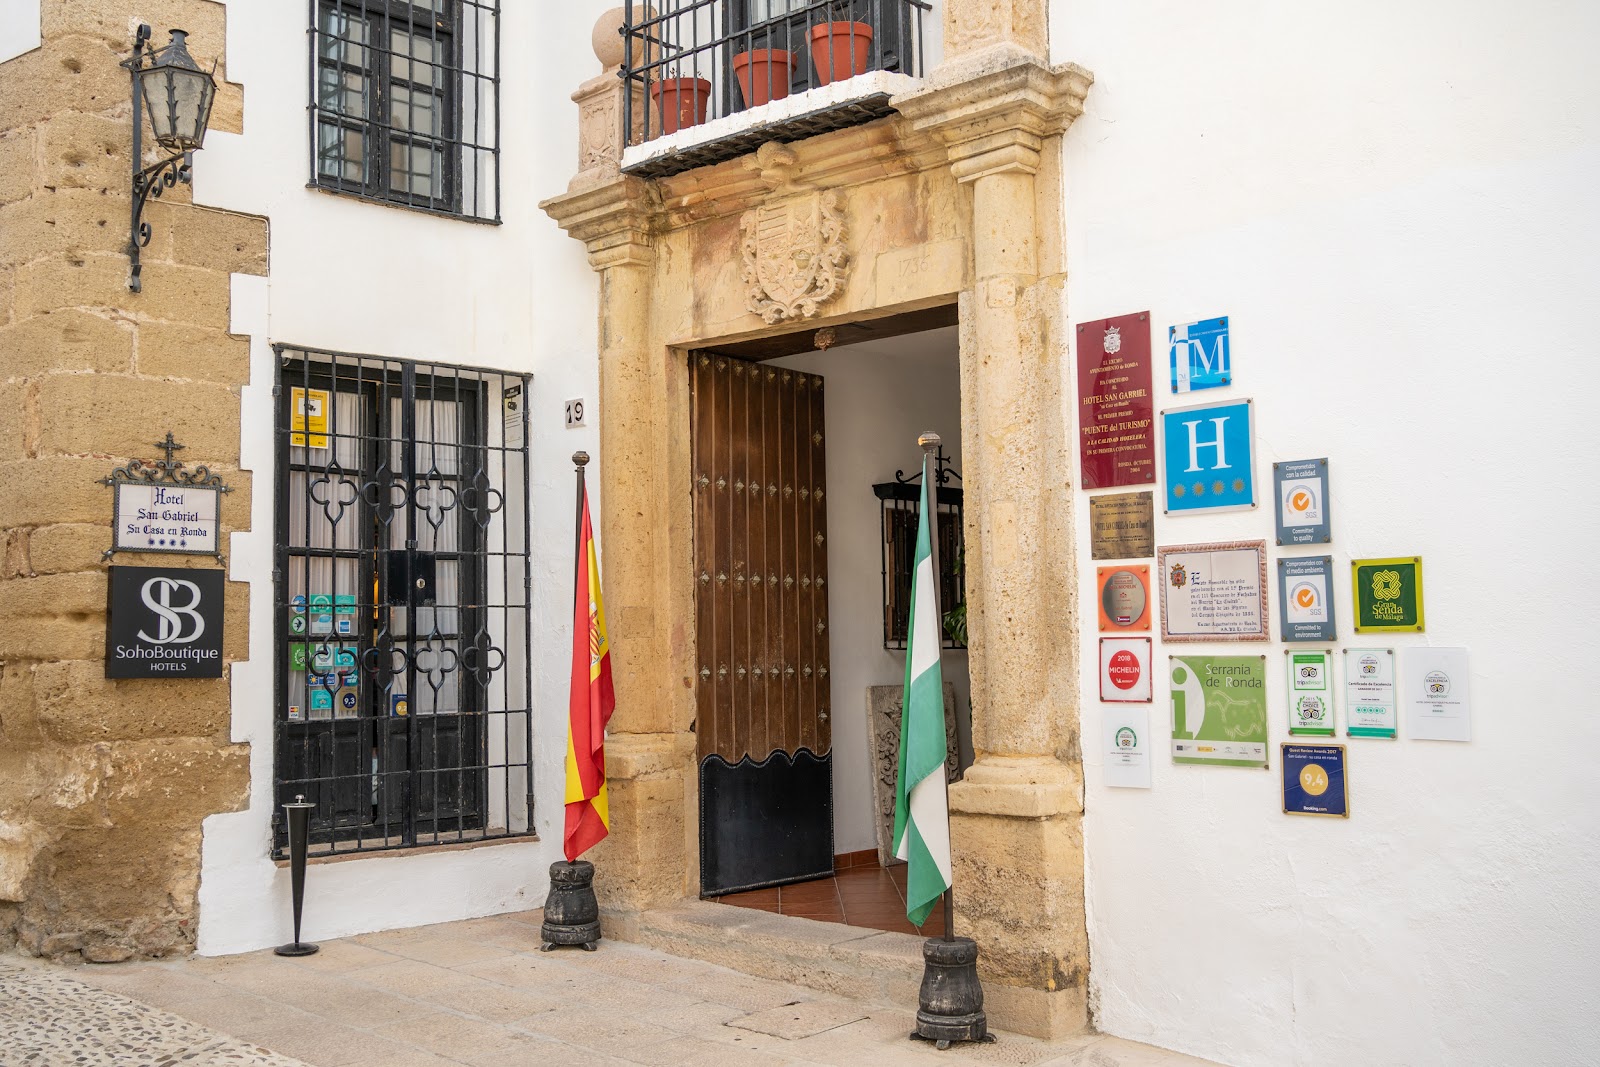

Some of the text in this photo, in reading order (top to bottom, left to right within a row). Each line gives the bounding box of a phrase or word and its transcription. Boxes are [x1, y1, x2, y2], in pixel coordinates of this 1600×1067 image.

[1083, 389, 1147, 405] HOTEL SAN GABRIEL
[566, 402, 584, 424] 19
[1082, 424, 1108, 434] "PUENTE
[1119, 419, 1150, 431] TURISMO"
[1182, 416, 1232, 472] H
[154, 487, 184, 506] Hotel
[137, 508, 198, 522] San Gabriel
[126, 524, 140, 535] Su
[144, 525, 164, 535] Casa
[180, 527, 207, 537] Ronda
[1372, 604, 1403, 614] Senda
[1383, 614, 1403, 622] Málaga
[116, 644, 218, 663] SohoBoutique
[1206, 677, 1261, 688] de Ronda
[1305, 773, 1324, 786] 9,4
